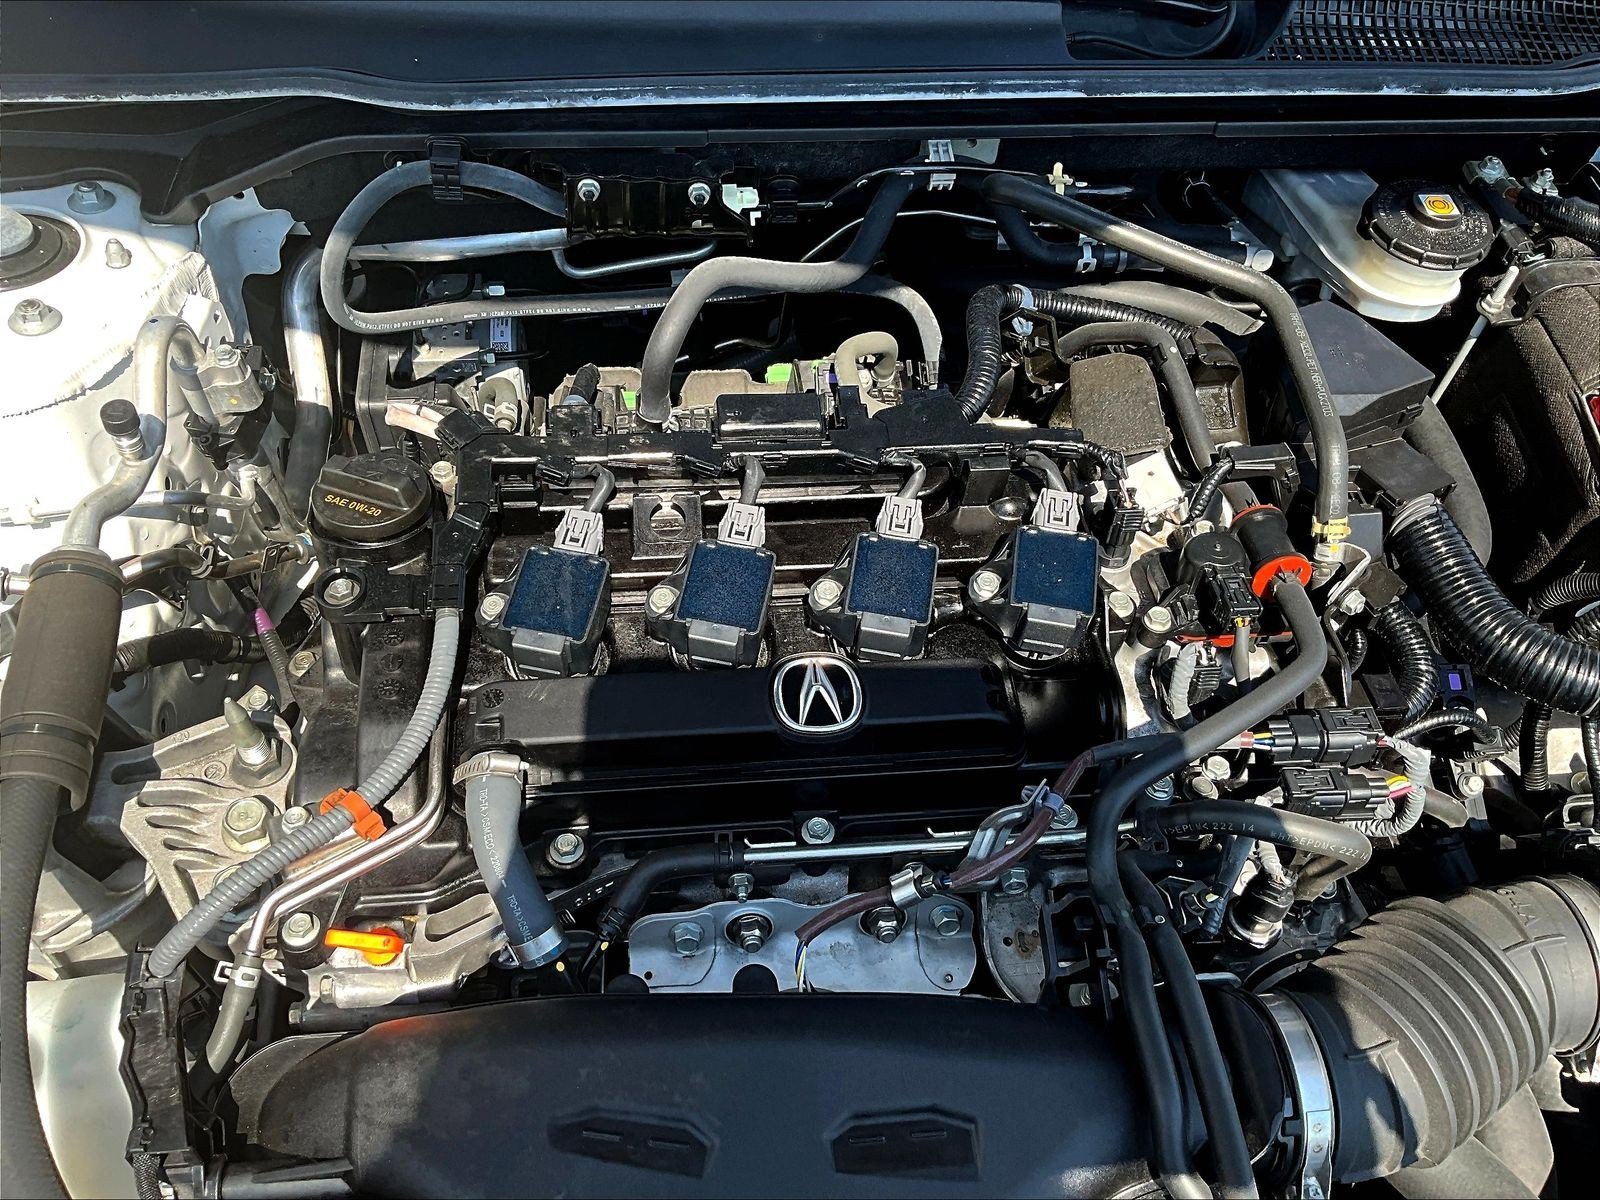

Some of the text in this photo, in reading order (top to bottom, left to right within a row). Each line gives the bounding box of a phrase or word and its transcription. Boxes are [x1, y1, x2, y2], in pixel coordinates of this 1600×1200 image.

[324, 494, 382, 517] SAE 0W-20
[1213, 822, 1233, 831] 222
[1242, 823, 1254, 832] 14
[1339, 846, 1359, 857] 222
